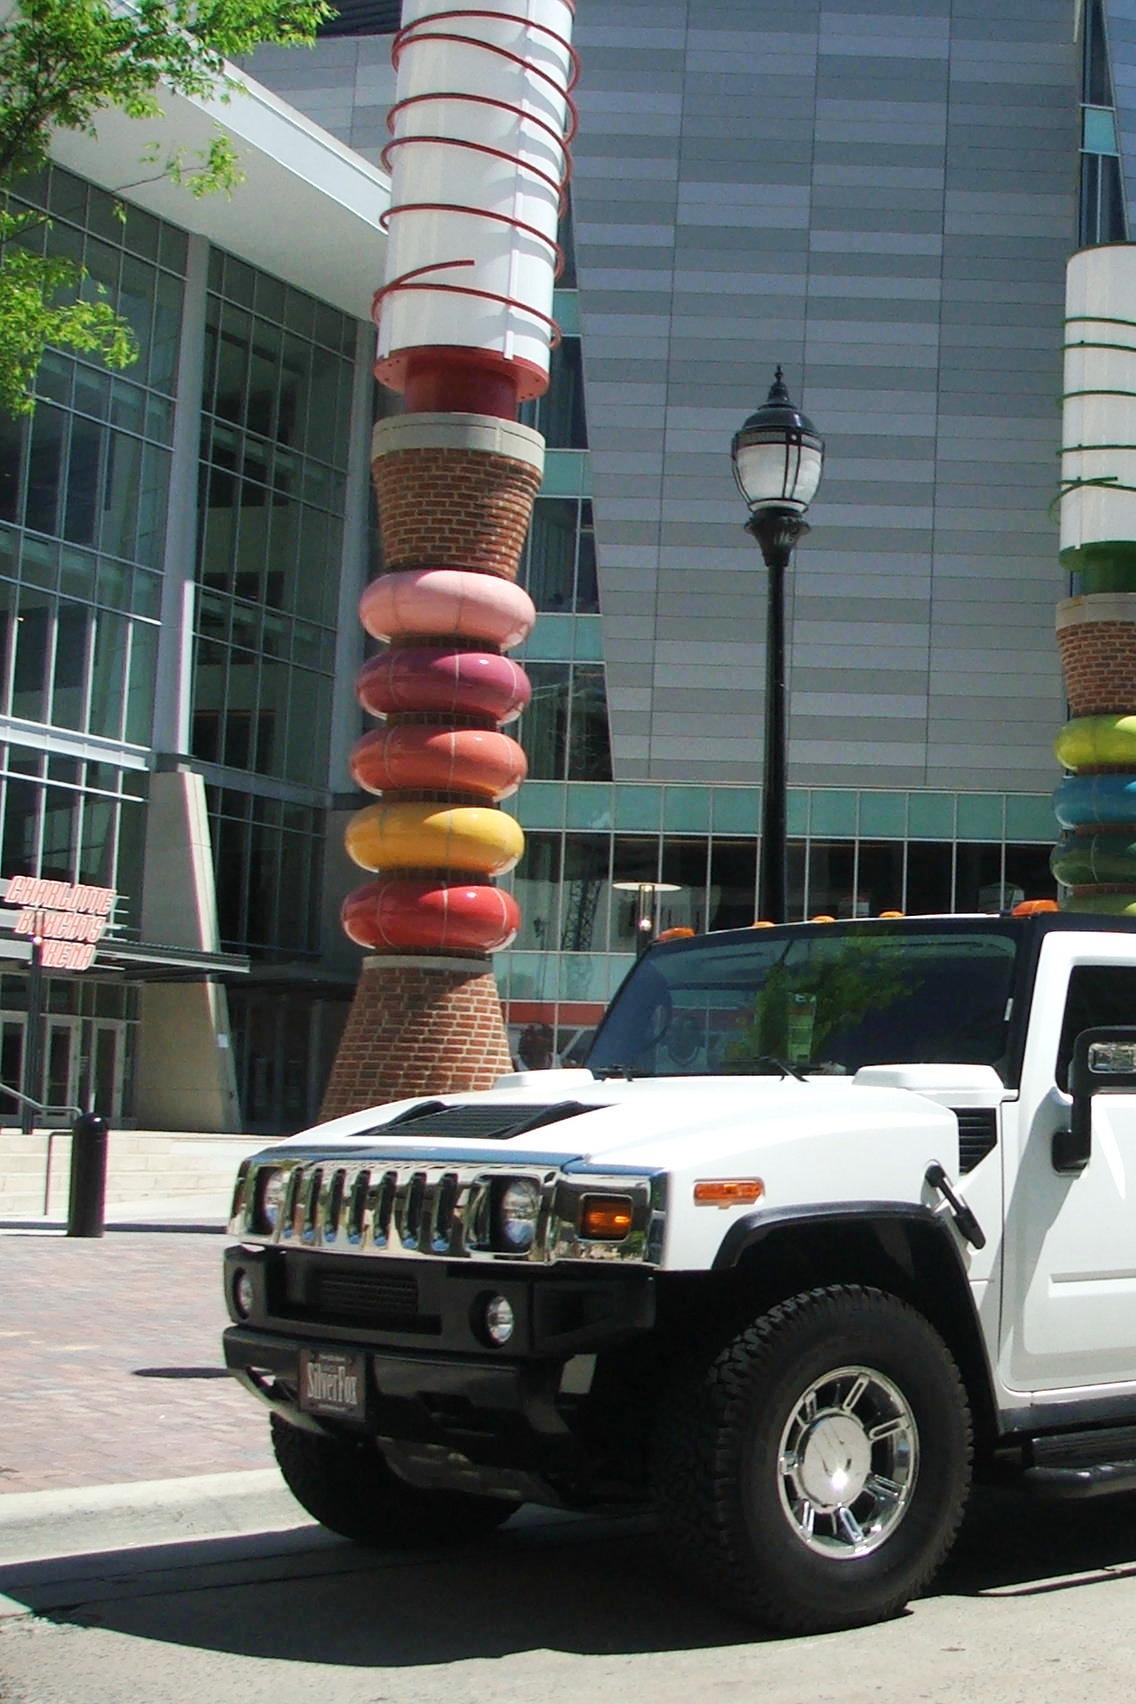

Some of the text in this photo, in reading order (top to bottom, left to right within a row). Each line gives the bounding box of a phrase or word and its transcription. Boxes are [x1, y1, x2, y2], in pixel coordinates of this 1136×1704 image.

[4, 875, 117, 916] CHARLOTTE
[14, 905, 107, 944] BBCATS
[30, 937, 97, 972] RENA
